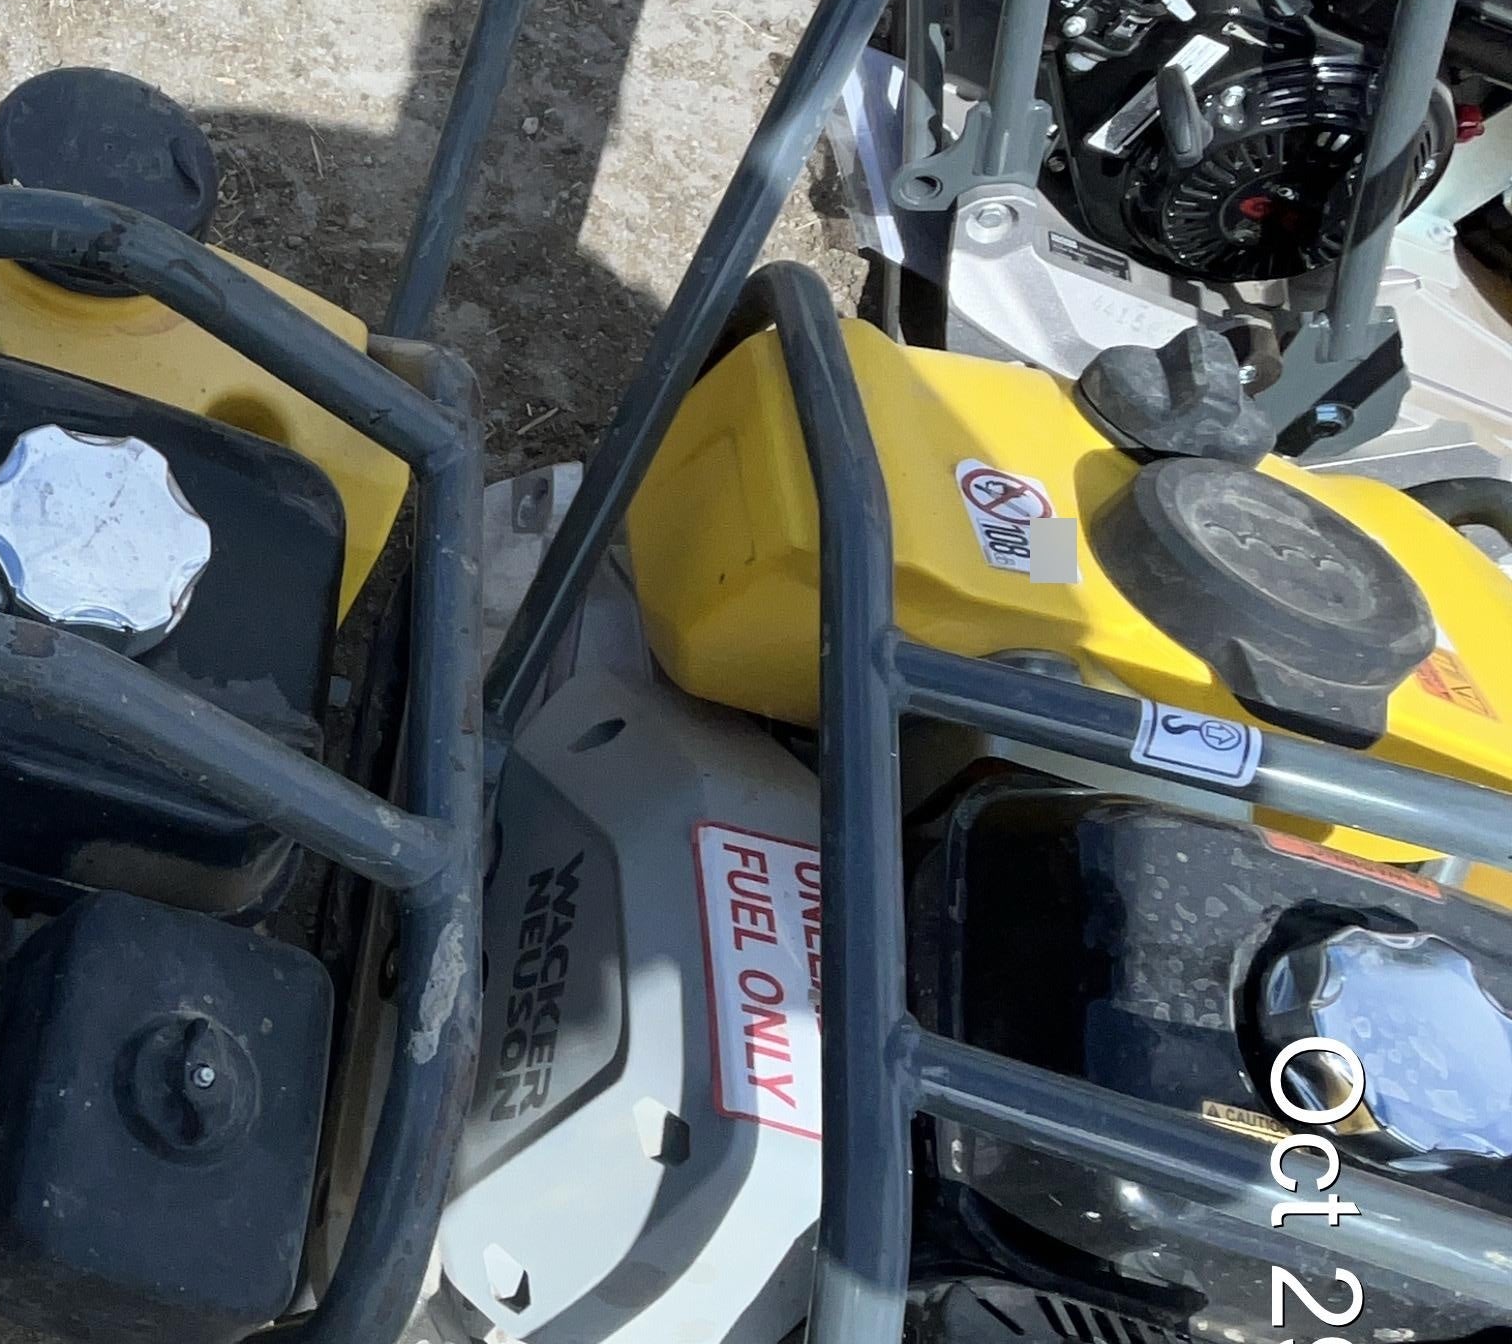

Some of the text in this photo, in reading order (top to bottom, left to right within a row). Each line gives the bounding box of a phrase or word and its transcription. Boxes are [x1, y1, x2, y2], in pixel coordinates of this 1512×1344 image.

[981, 523, 1031, 558] 108
[489, 866, 555, 1122] NEUSON
[518, 850, 585, 1114] WACKER
[723, 842, 797, 1110] FUEL ONLY
